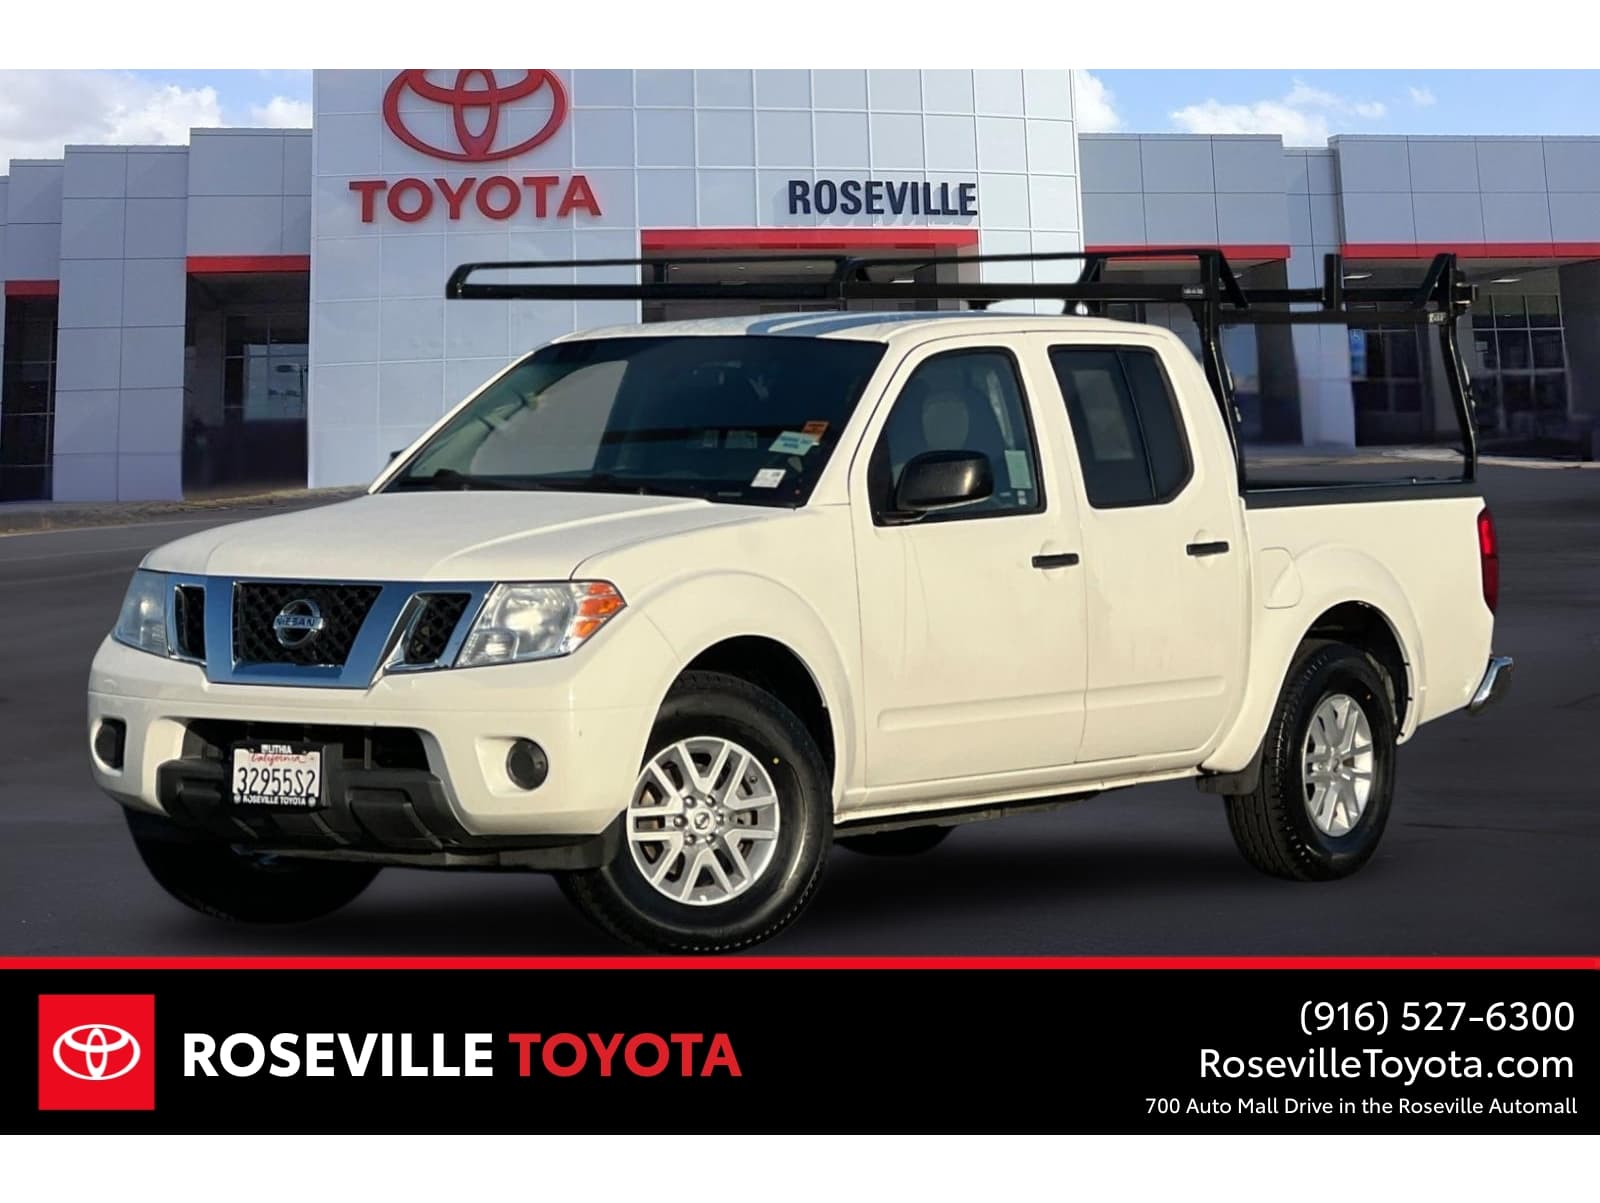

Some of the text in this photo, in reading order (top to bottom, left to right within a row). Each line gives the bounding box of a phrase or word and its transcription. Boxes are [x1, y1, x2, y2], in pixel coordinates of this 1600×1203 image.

[350, 175, 602, 224] TOYOTA
[788, 179, 979, 217] ROSEVILLE
[275, 615, 316, 628] NISSAN
[268, 744, 292, 754] LITHIA
[250, 753, 306, 767] California
[236, 767, 316, 797] 32955S2
[242, 795, 306, 806] ROSEVILLE TOYOTA
